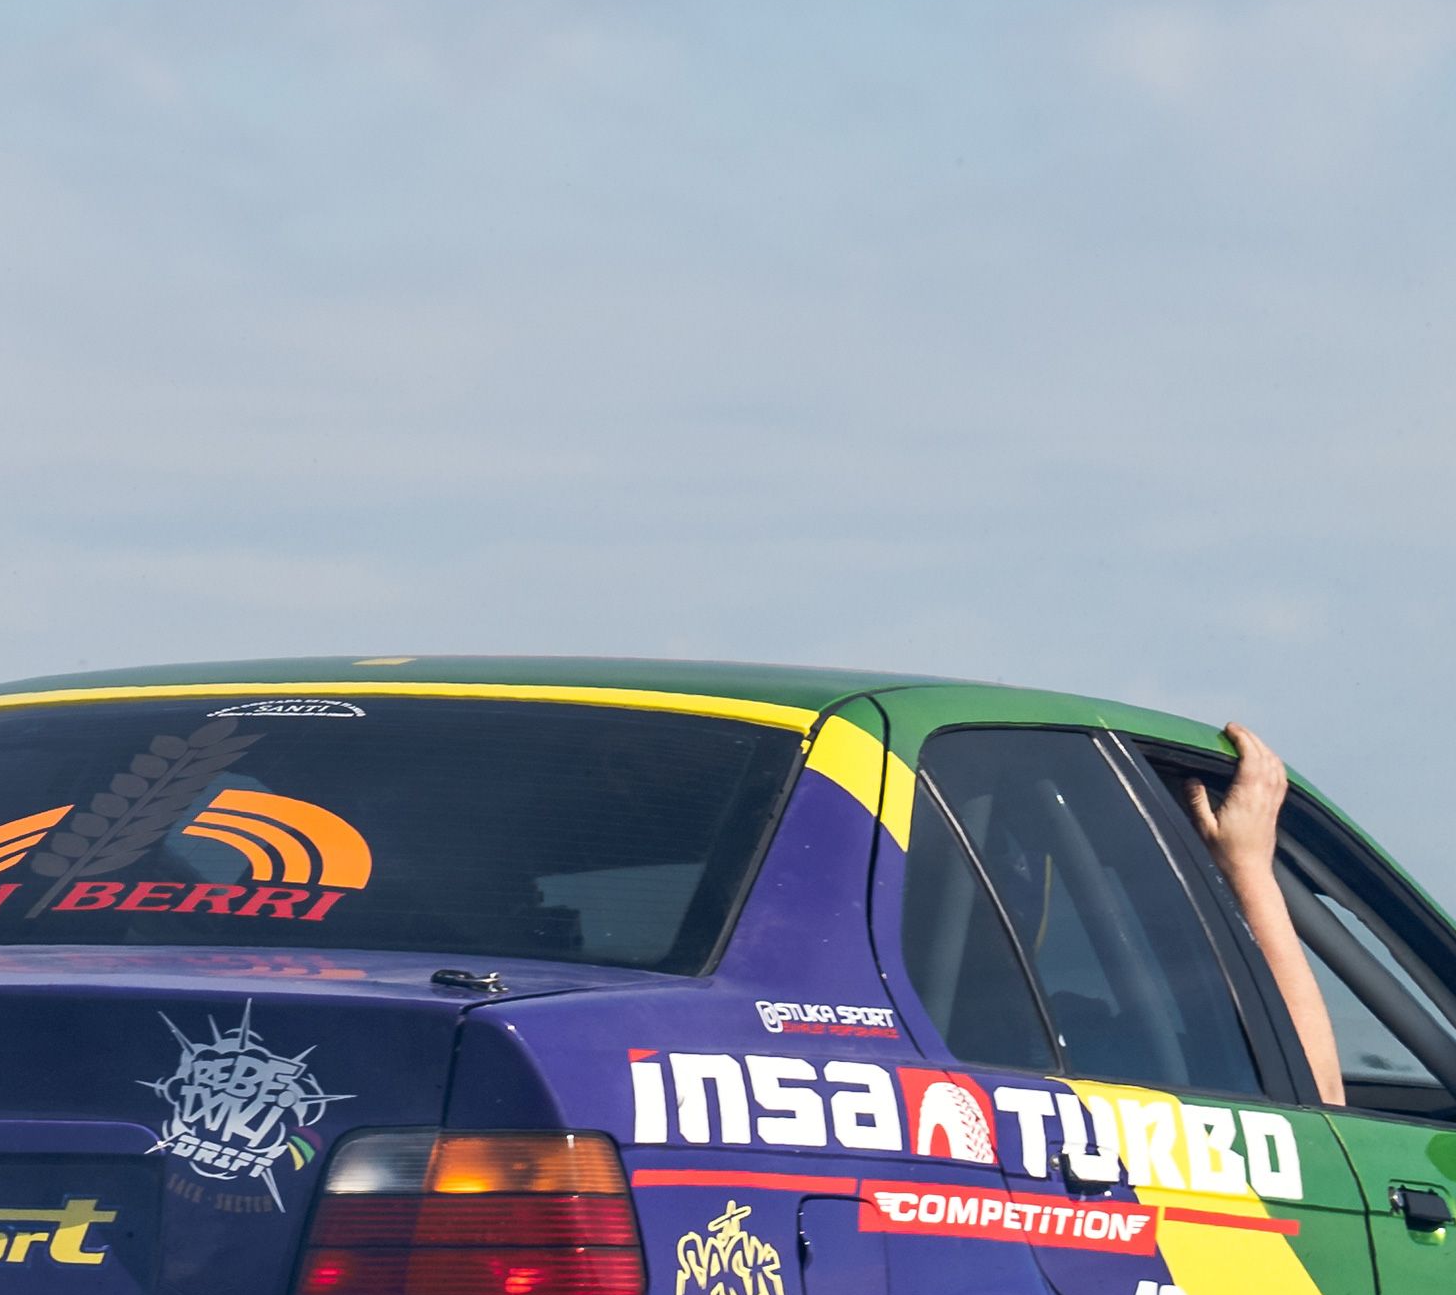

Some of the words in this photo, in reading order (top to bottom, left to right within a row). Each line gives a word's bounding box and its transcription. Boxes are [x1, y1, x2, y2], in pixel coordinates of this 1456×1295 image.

[255, 705, 330, 713] SANTI
[51, 881, 346, 921] BERRI
[836, 1006, 893, 1027] SPORT
[171, 1135, 276, 1177] DRIFT
[993, 1087, 1303, 1200] TURBO
